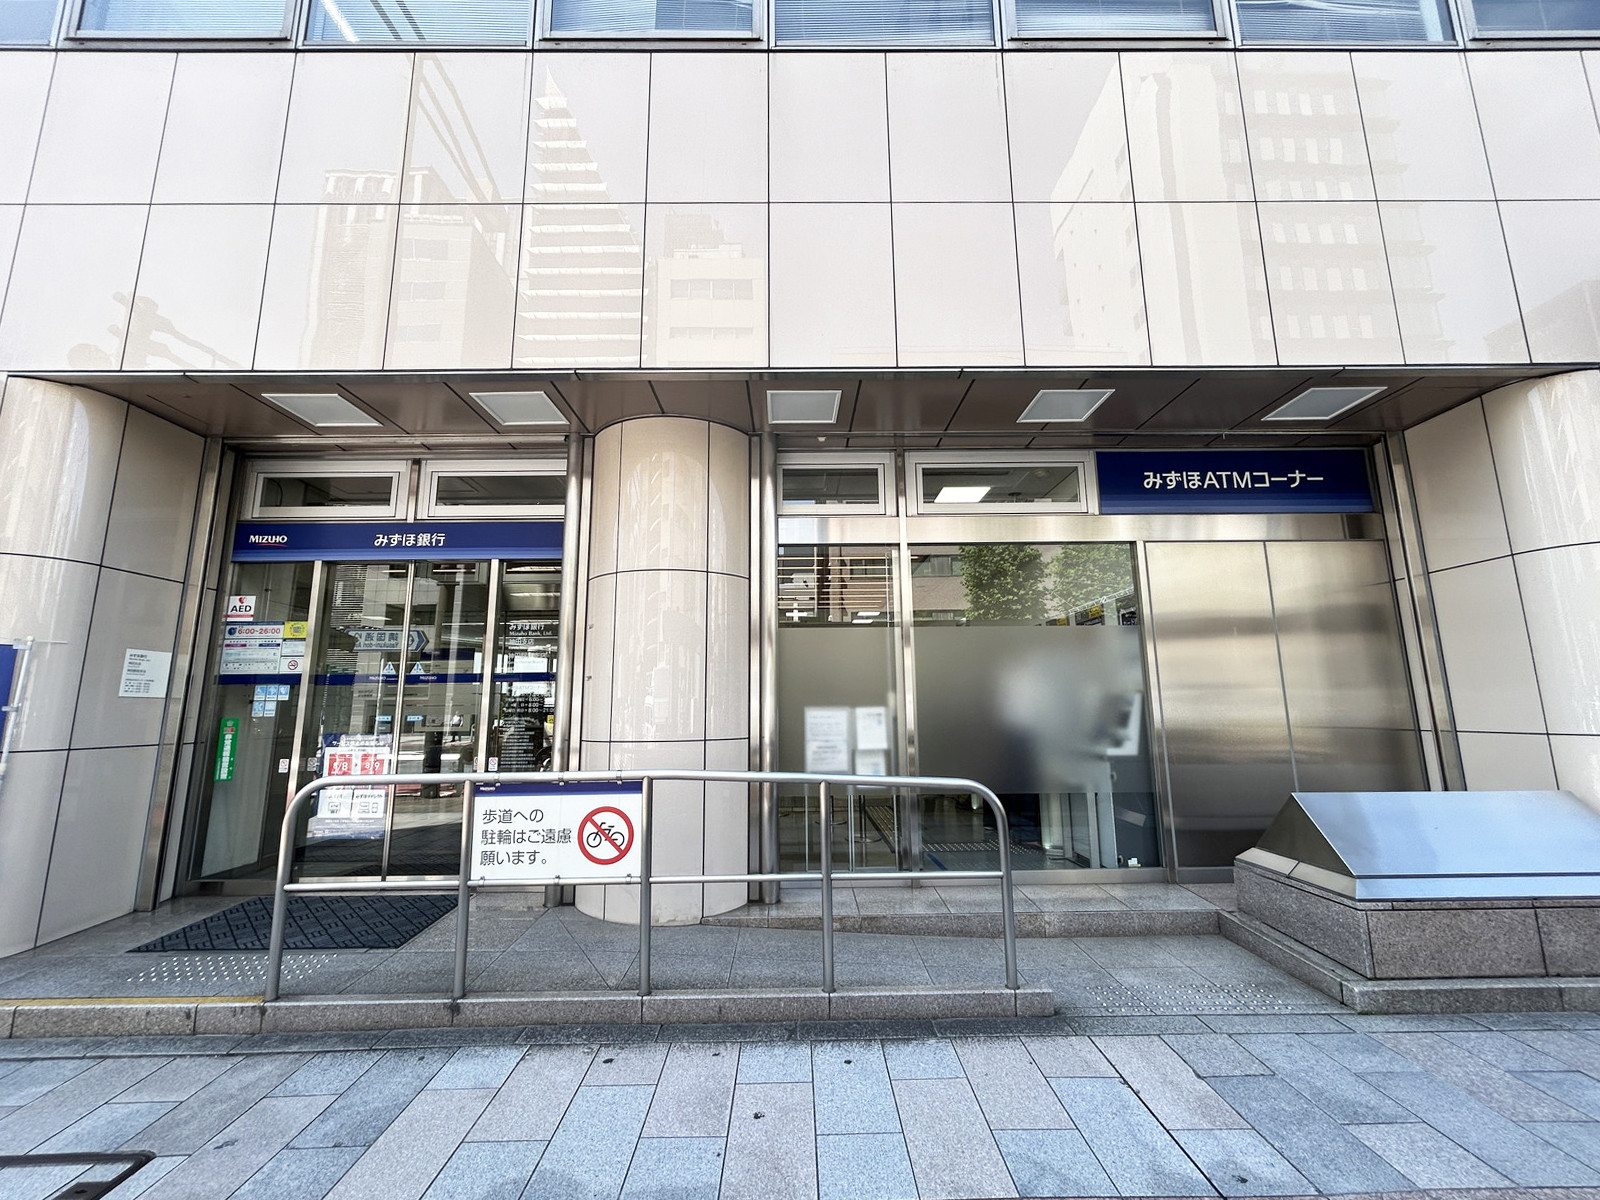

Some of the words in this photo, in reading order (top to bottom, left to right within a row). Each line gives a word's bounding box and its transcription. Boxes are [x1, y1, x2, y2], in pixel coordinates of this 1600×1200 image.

[1142, 470, 1324, 490] みずほATMコーナー
[248, 534, 288, 544] MIZUHO
[373, 533, 446, 547] みずほ銀行
[230, 605, 252, 613] AED
[482, 809, 544, 824] 歩道への
[481, 828, 572, 845] 駐輪はご遠慮
[479, 850, 548, 866] 願います。
